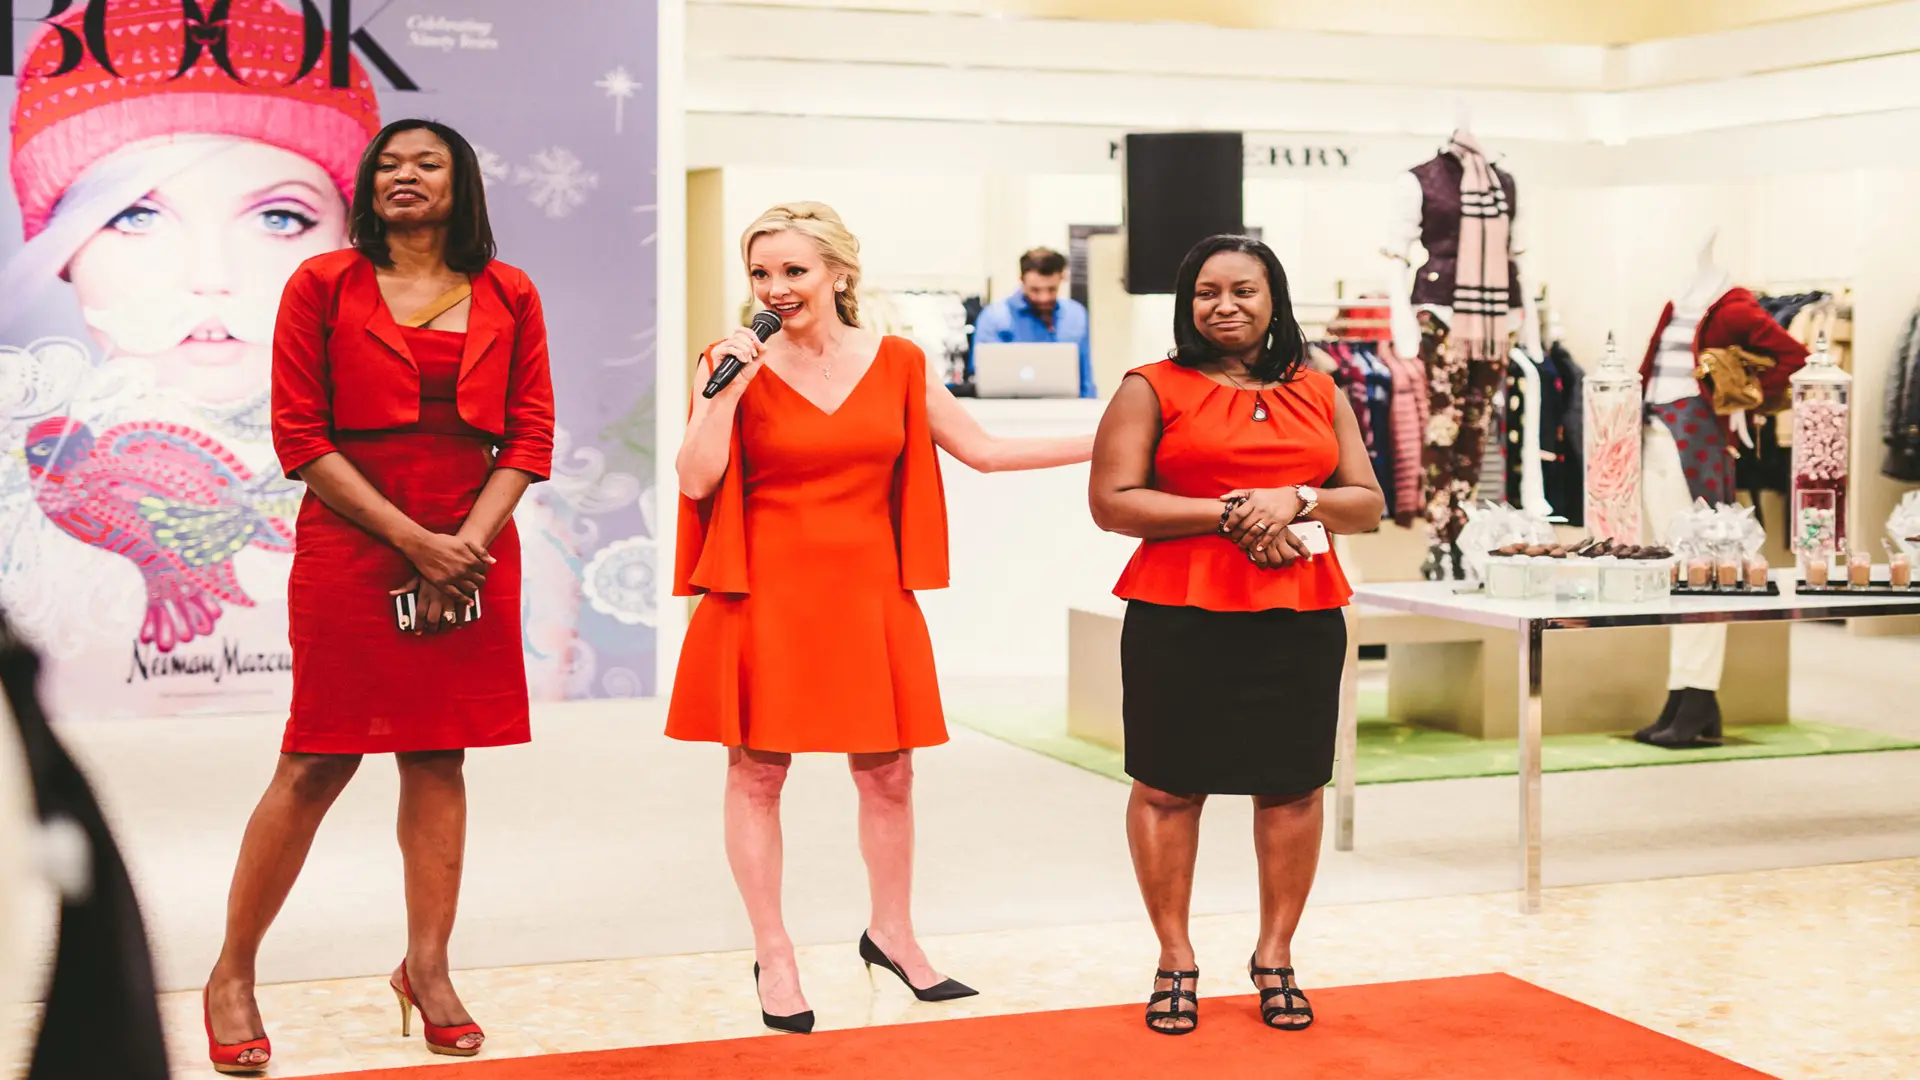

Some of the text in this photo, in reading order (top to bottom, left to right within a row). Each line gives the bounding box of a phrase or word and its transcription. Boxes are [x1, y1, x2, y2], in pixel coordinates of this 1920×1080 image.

[0, 0, 425, 92] BOOK
[406, 14, 493, 37] Celebrating
[127, 637, 293, 683] Neiman Marcu
